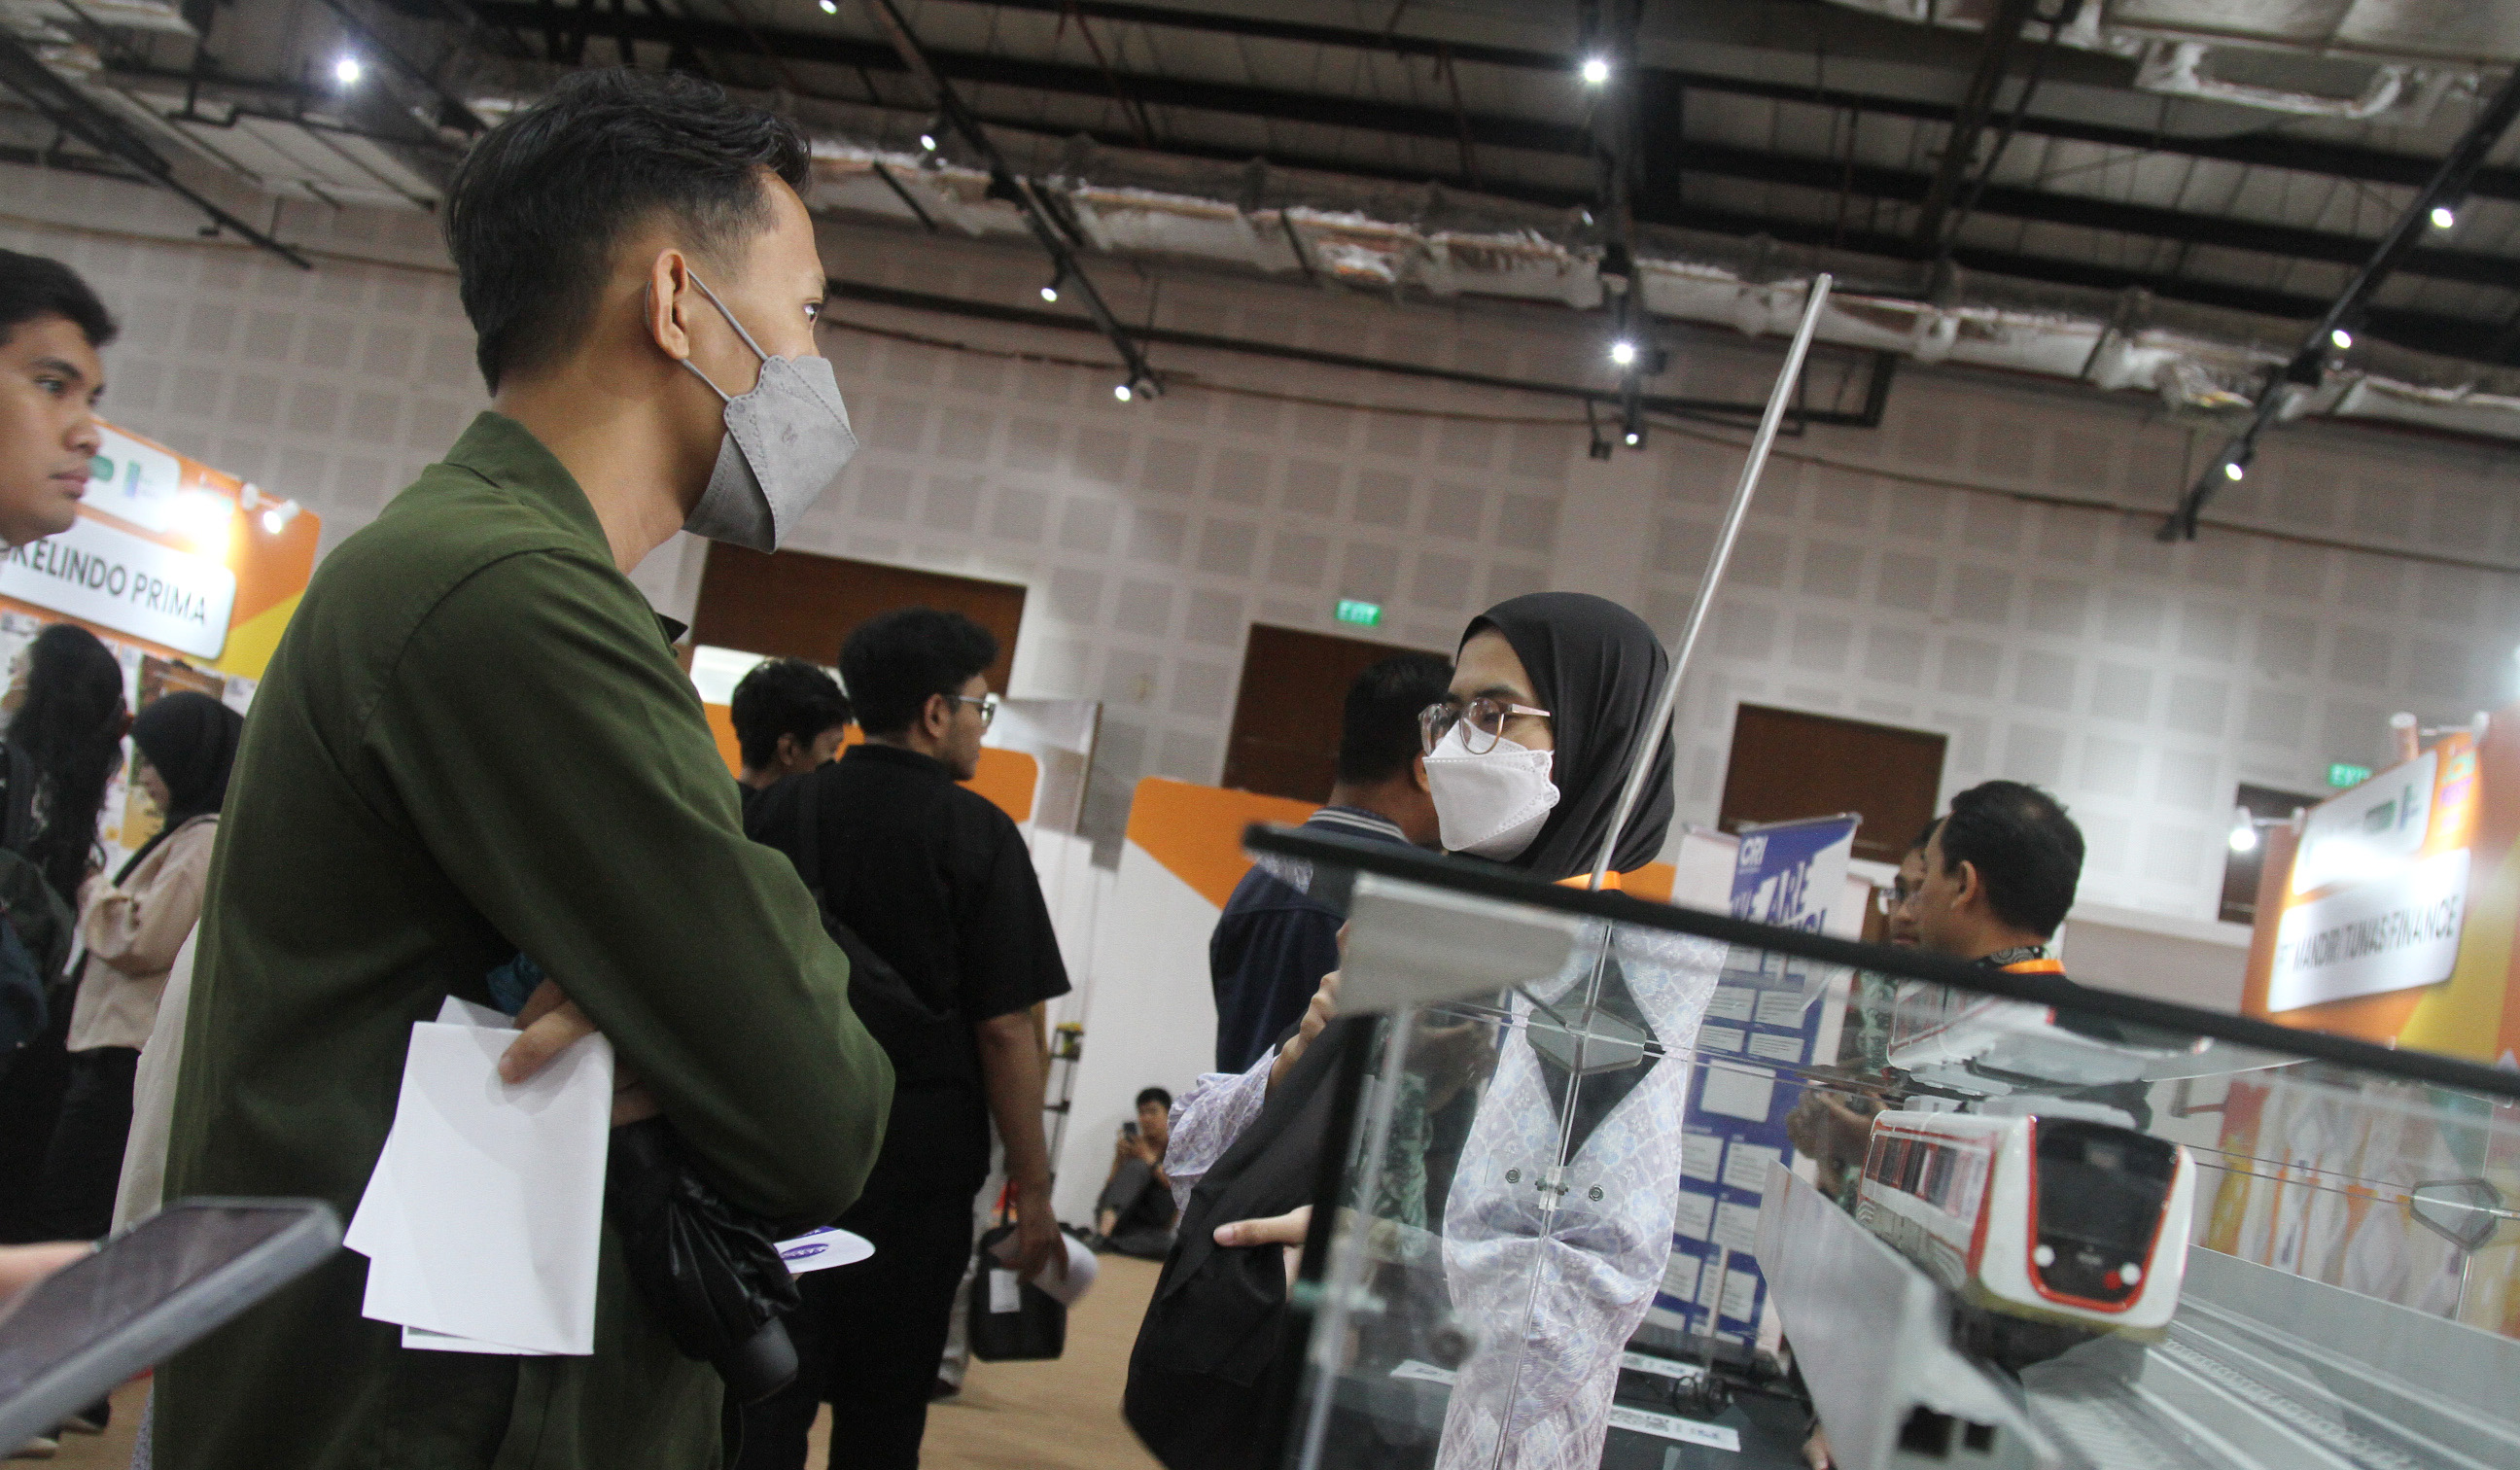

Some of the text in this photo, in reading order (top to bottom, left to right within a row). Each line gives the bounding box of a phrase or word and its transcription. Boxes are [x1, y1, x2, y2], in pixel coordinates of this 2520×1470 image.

[130, 571, 206, 625] PRIMA
[2344, 917, 2389, 960] TUNAS
[2389, 894, 2459, 951] FINANCE
